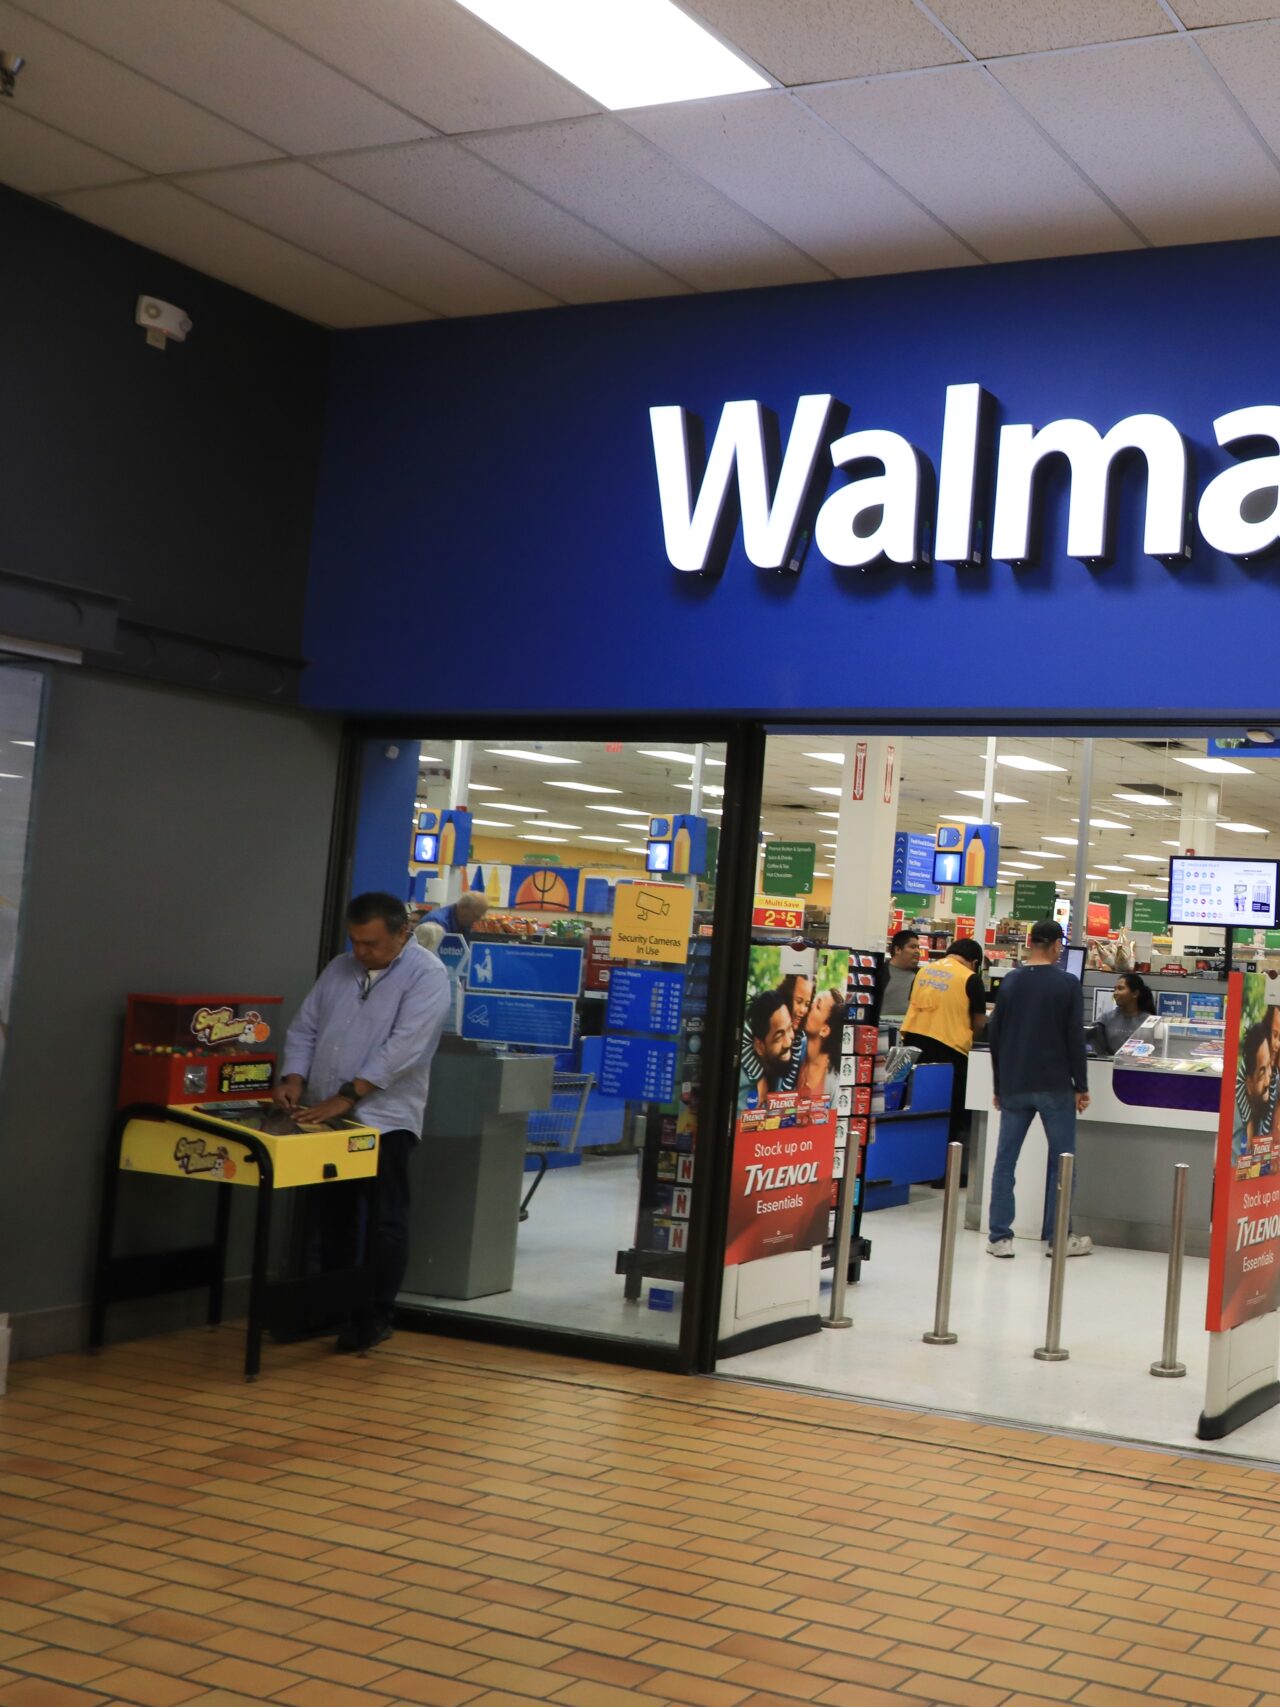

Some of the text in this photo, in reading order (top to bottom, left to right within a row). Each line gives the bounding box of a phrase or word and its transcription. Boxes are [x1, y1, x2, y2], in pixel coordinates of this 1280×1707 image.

[422, 835, 434, 858] 3
[656, 842, 668, 867] 2
[943, 856, 954, 880] 1
[804, 883, 810, 891] 2
[784, 900, 800, 908] Save
[764, 910, 776, 926] 2
[618, 933, 681, 947] Security Cameras
[645, 946, 660, 956] Use
[607, 1038, 630, 1046] Pharmacy
[769, 1099, 796, 1110] TYLENOL
[742, 1113, 765, 1122] TYLENOL
[755, 1140, 813, 1158] Stock up on
[1254, 1143, 1271, 1154] TYLENOL
[682, 1158, 691, 1179] N
[744, 1162, 818, 1197] TYLENOL
[676, 1194, 686, 1214] N
[756, 1194, 803, 1214] Essentials
[1243, 1189, 1280, 1209] Stock up on
[673, 1228, 682, 1248] N
[1242, 1252, 1274, 1273] Essentials
